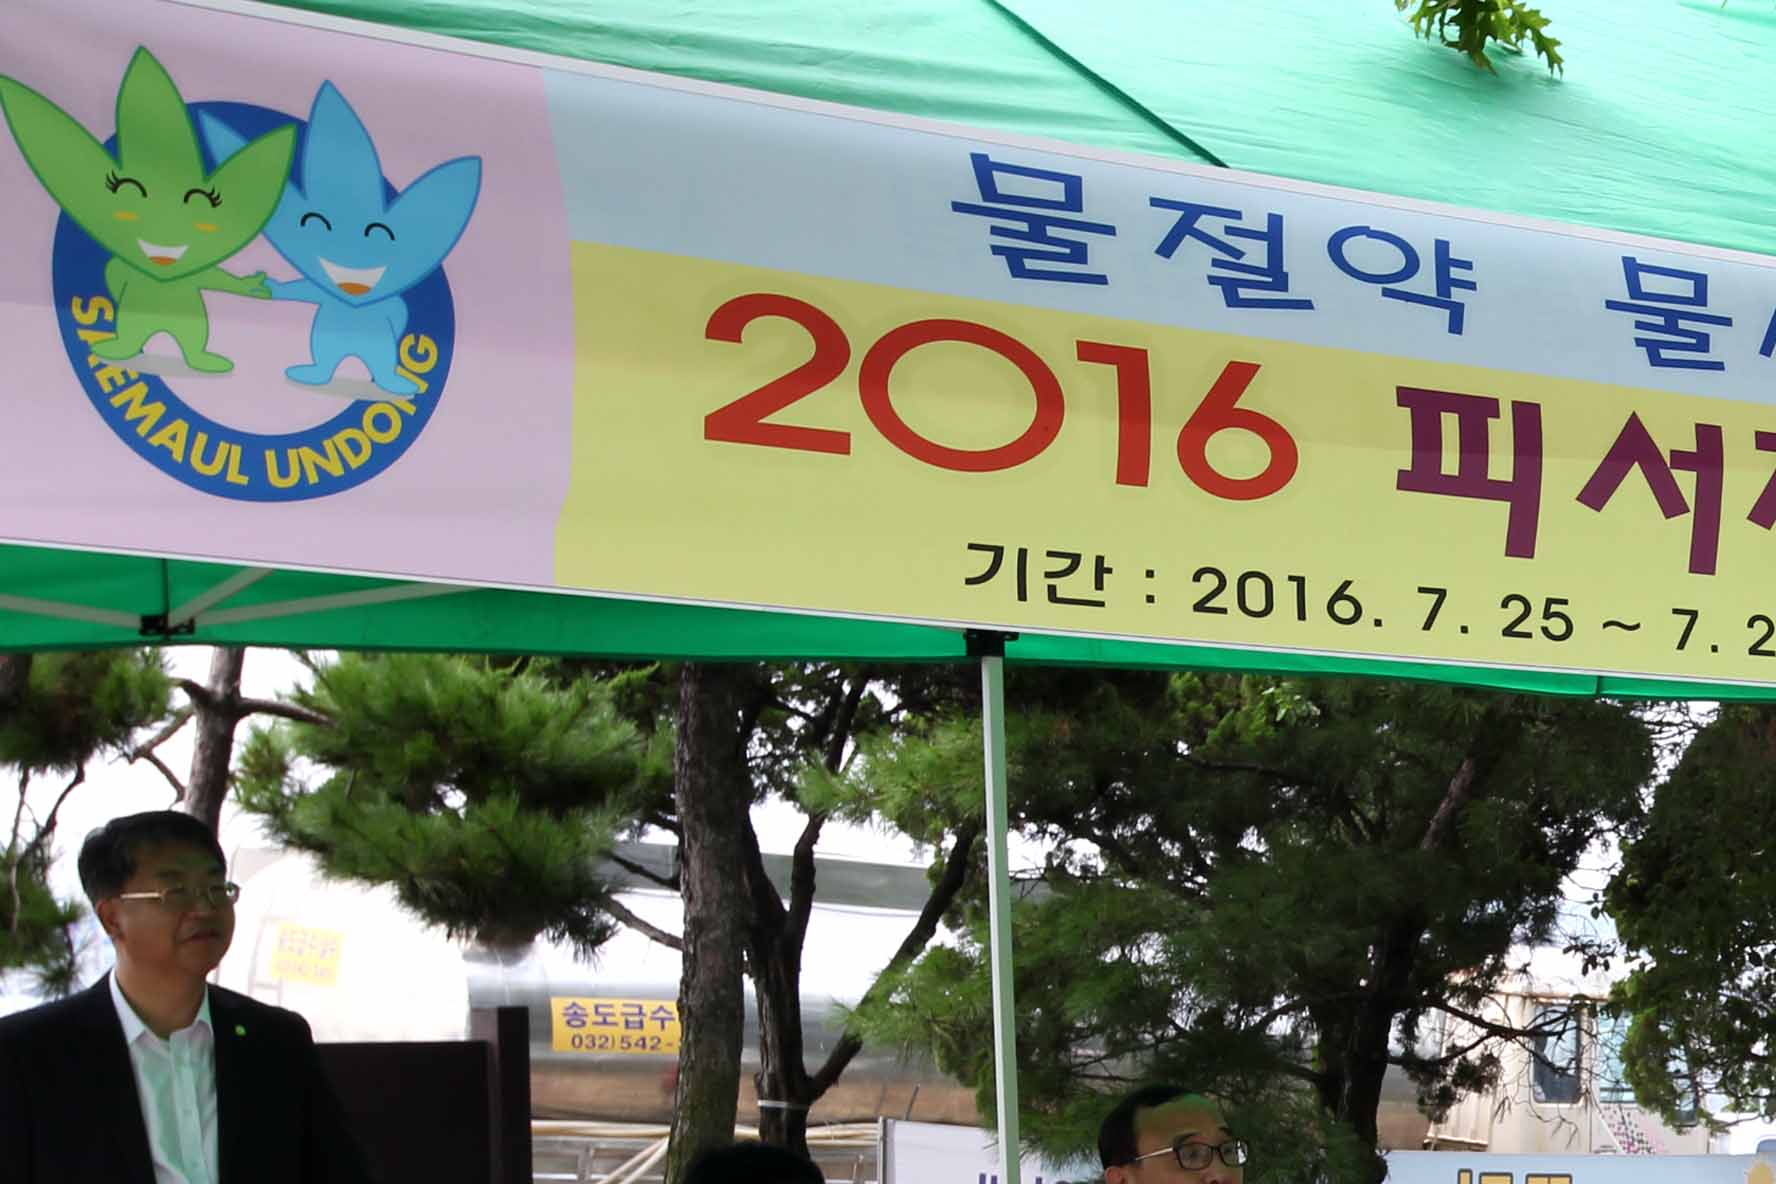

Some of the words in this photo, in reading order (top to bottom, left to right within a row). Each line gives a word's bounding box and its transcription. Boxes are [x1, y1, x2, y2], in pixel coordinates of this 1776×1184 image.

[950, 152, 1477, 335] 물절약
[704, 293, 1299, 500] 2016
[563, 1002, 676, 1031] 송도급수
